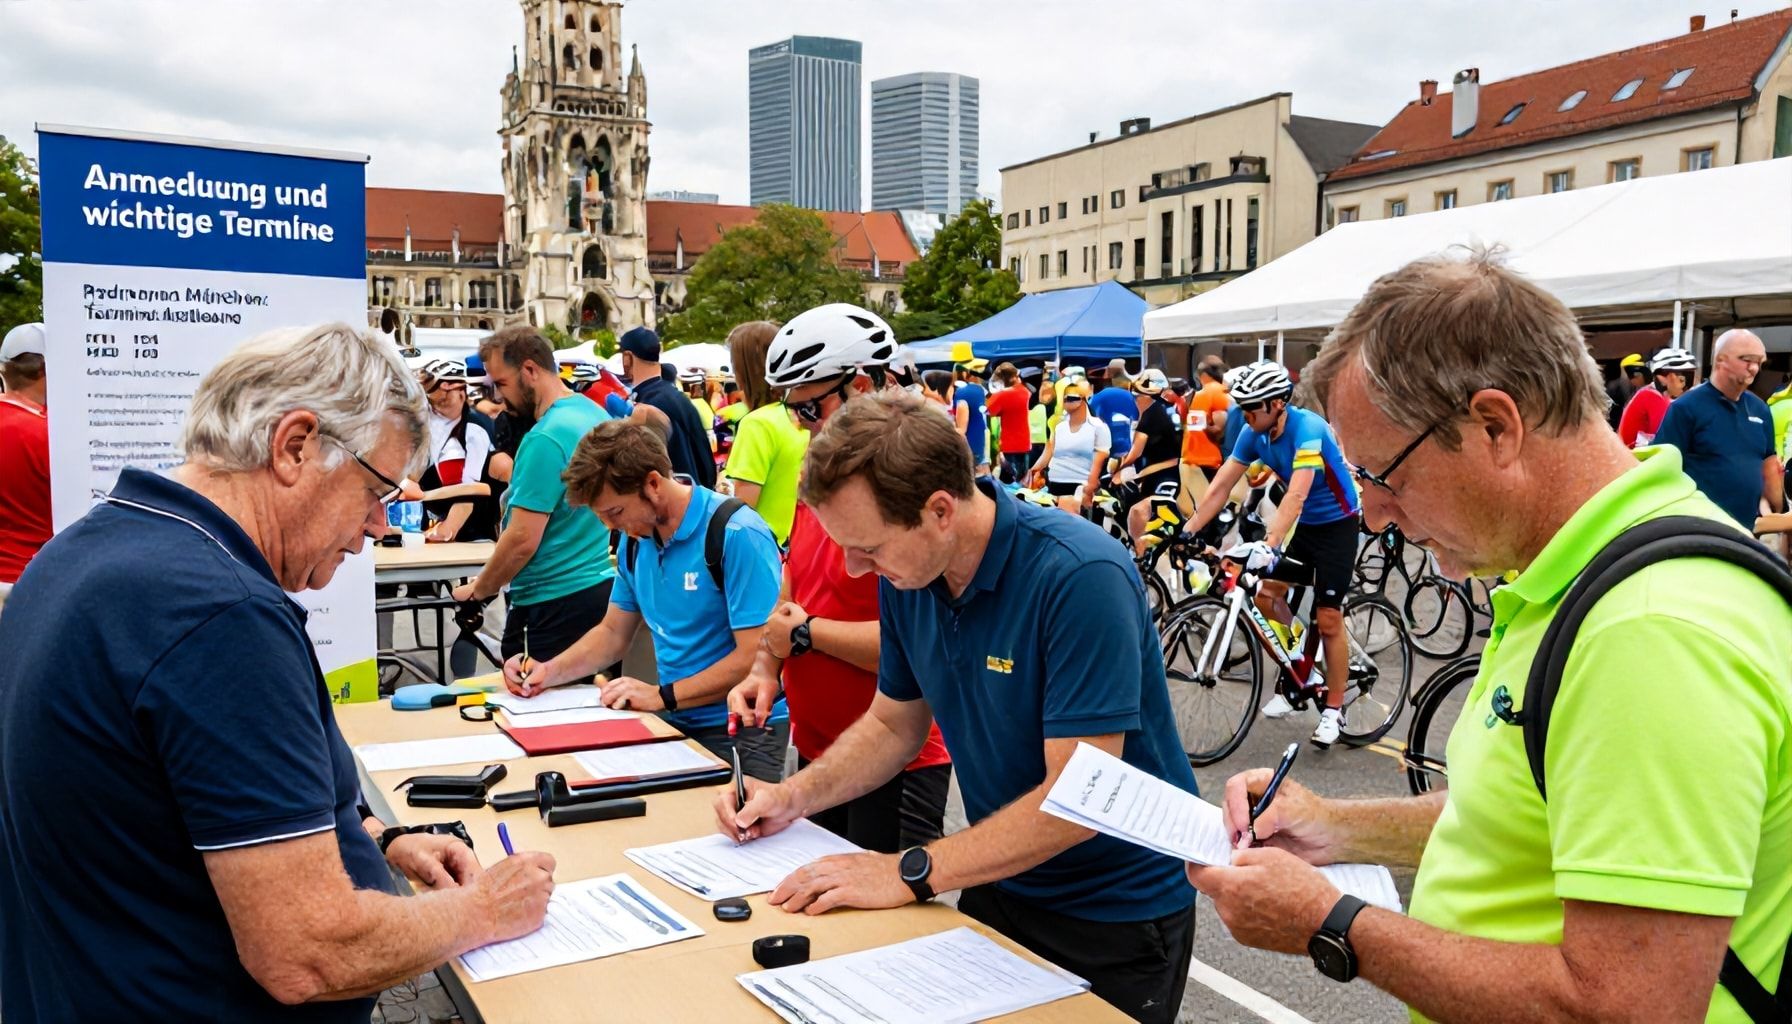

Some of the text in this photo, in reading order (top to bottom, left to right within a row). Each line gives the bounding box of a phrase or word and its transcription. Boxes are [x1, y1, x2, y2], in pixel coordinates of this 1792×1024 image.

[274, 183, 327, 208] und
[82, 199, 334, 242] wichtige Termine
